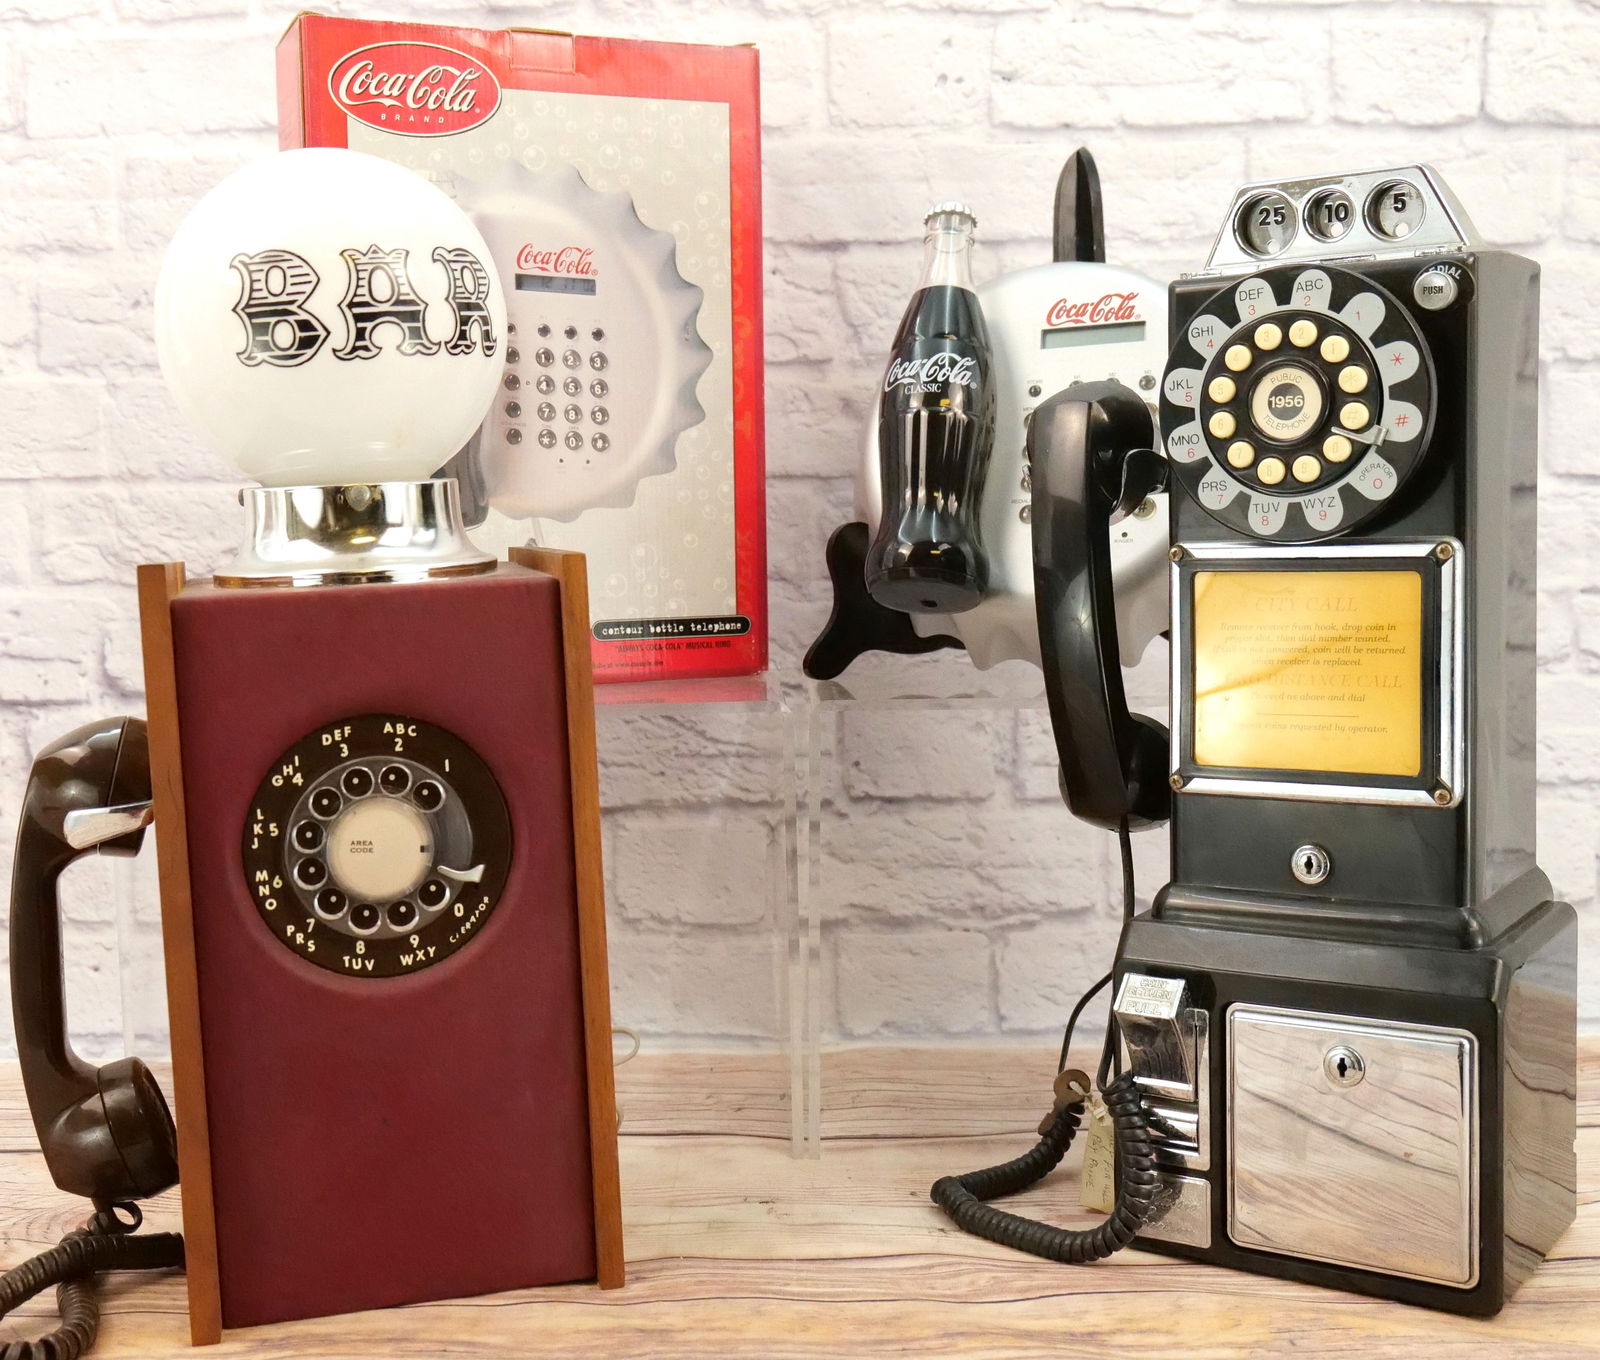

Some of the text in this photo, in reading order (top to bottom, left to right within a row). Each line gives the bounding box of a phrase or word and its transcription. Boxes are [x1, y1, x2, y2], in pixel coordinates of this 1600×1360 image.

[339, 60, 482, 113] Coca-Cola
[1259, 192, 1407, 227] 25 10 5
[516, 243, 595, 276] Coca-Cola
[1428, 264, 1462, 280] DIAL
[1295, 278, 1324, 293] ABC
[1422, 285, 1444, 295] PUSH
[1238, 287, 1265, 302] DEF
[1303, 295, 1312, 306] 2
[229, 243, 497, 368] BAR
[1046, 292, 1139, 327] Coca-Cola
[1247, 304, 1256, 316] 3
[1190, 325, 1214, 339] GHI
[1206, 338, 1214, 350] 4
[540, 353, 546, 363] 1
[567, 355, 574, 366] 2
[594, 357, 601, 367] 3
[885, 352, 977, 392] Coca-Cola
[1269, 372, 1303, 385] PUBLIC
[540, 381, 547, 391] 4
[568, 382, 575, 393] 5
[595, 384, 602, 395] 6
[904, 383, 942, 394] CLASSIC
[1169, 377, 1195, 392] JKL
[1185, 391, 1192, 403] 5
[1269, 395, 1304, 409] 1956
[542, 408, 550, 418] 7
[568, 410, 576, 420] 8
[595, 411, 603, 421] 9
[1262, 412, 1311, 432] TELEPHONE
[569, 437, 576, 448] 0
[1170, 433, 1200, 447] MNO
[1187, 447, 1195, 459] 6
[1358, 462, 1394, 483] OPERATOR
[1201, 480, 1228, 493] PRS
[1217, 493, 1225, 505] 7
[1303, 496, 1336, 510] WYZ
[1252, 502, 1281, 514] TUV
[1318, 509, 1327, 521] 9
[1261, 515, 1270, 527] 8
[1305, 596, 1359, 613] CALL
[601, 621, 742, 636] contour bottle telephone
[1291, 622, 1312, 633] from
[1341, 623, 1363, 634] drop
[1364, 624, 1385, 632] coin
[1386, 623, 1397, 632] in
[1298, 633, 1316, 642] dial
[1317, 634, 1353, 643] number
[1354, 634, 1391, 643] wanted.
[1312, 646, 1333, 654] coin
[1334, 645, 1352, 654] will
[1353, 646, 1364, 655] be
[1366, 646, 1406, 656] returned
[1312, 658, 1321, 666] is
[1322, 658, 1364, 668] replaced.
[1356, 673, 1402, 689] CALL
[1299, 692, 1326, 702] above
[1327, 693, 1346, 702] and
[1347, 693, 1366, 703] dial
[383, 722, 417, 737] ABC
[1334, 722, 1346, 733] by
[322, 726, 352, 746] DEF
[340, 743, 349, 757] 3
[394, 738, 403, 752] 2
[272, 755, 300, 787] GHI
[292, 772, 304, 786] 4
[268, 823, 279, 836] 5
[272, 875, 283, 889] 6
[306, 918, 315, 933] 7
[286, 924, 316, 952] PRS
[409, 934, 419, 948] 9
[355, 940, 366, 954] 8
[343, 955, 375, 971] TUV
[399, 946, 437, 966] WXY
[1124, 999, 1162, 1016] PULL
